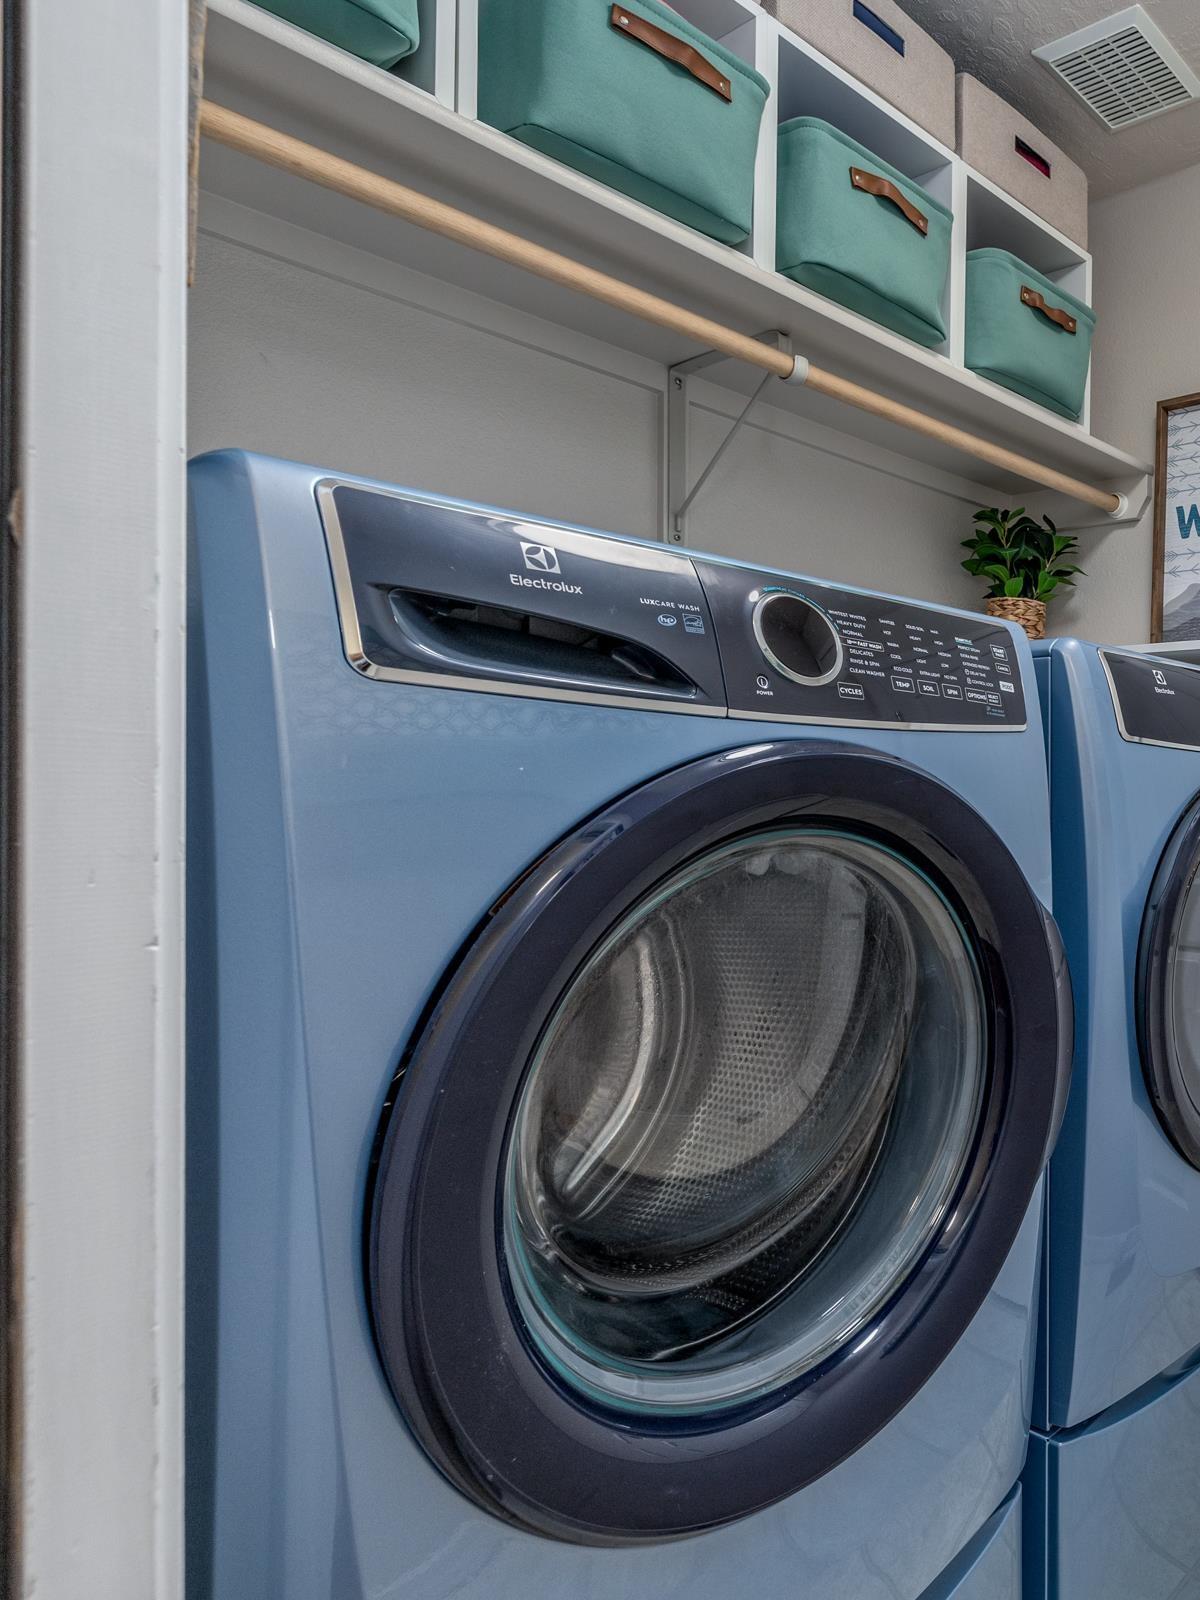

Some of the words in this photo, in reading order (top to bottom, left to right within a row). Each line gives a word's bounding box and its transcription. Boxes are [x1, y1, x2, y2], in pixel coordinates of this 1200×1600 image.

[509, 573, 583, 595] Electrolux
[640, 597, 676, 609] LUXCARE
[678, 603, 700, 612] WASH
[843, 629, 864, 637] NORMAL
[850, 648, 874, 657] DELICATES
[840, 687, 863, 696] CYCLES
